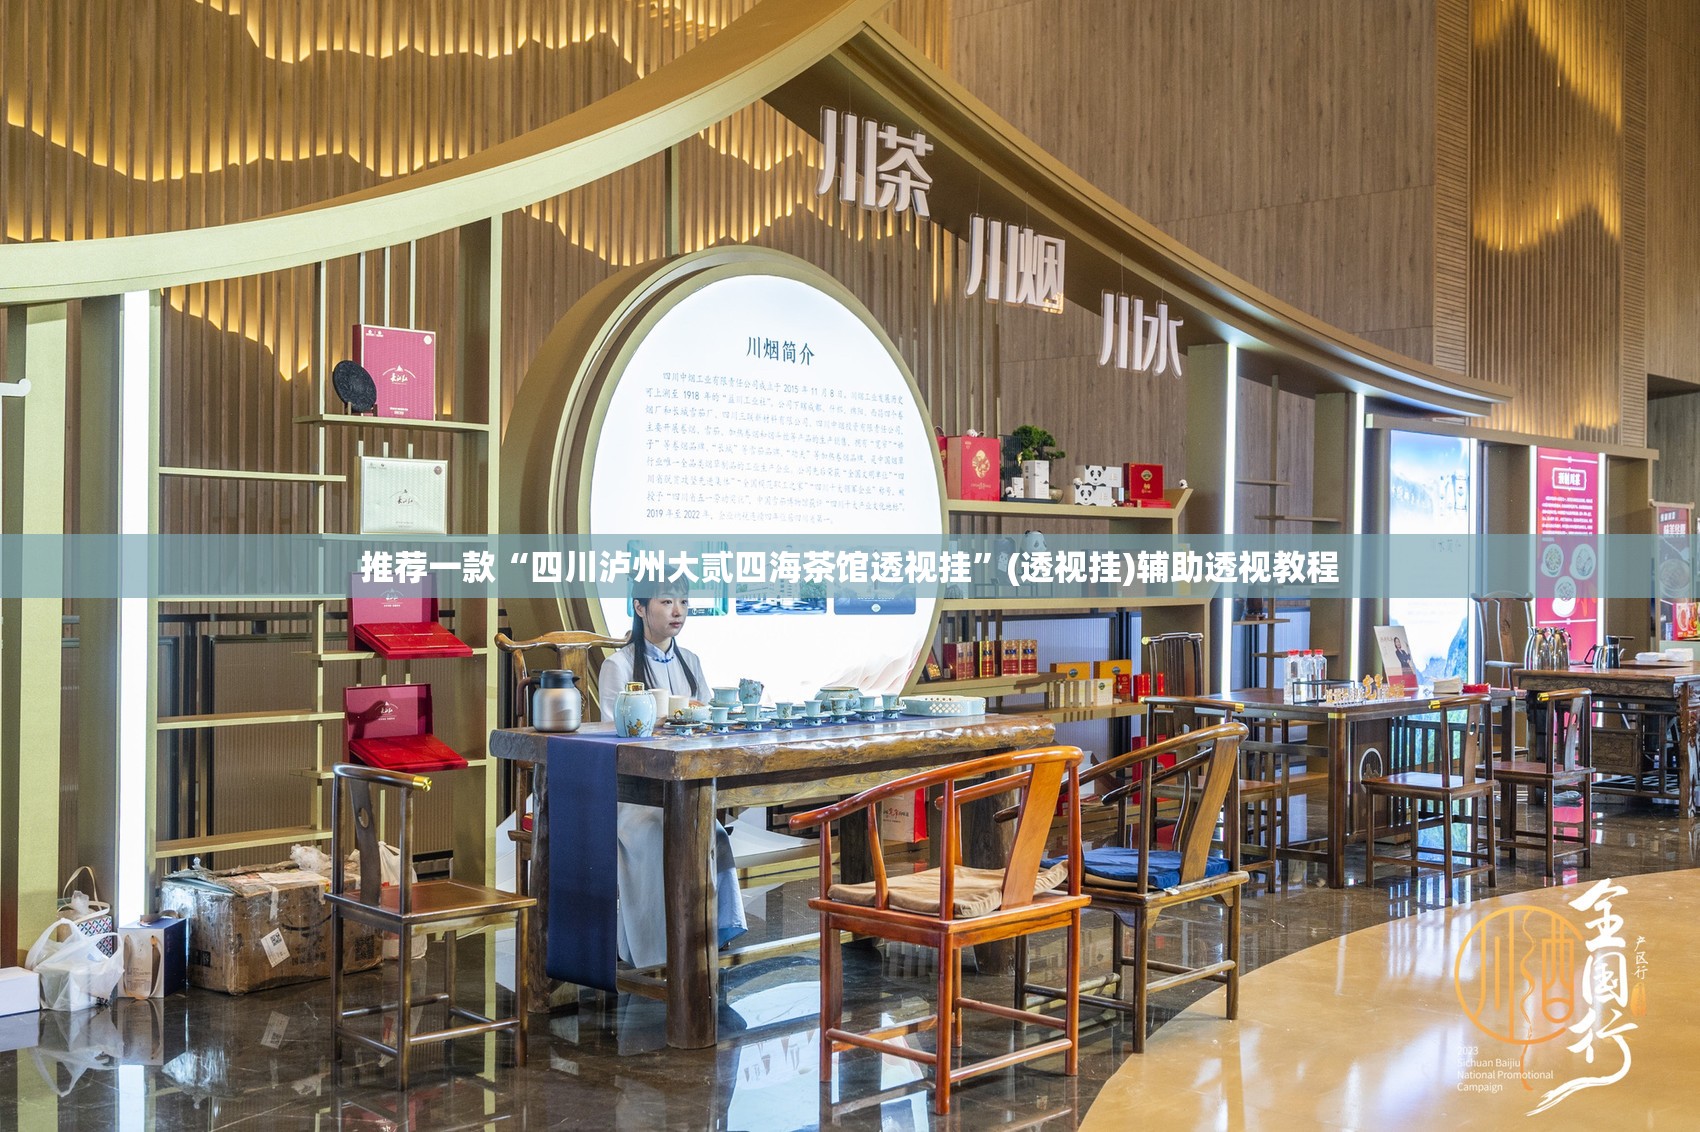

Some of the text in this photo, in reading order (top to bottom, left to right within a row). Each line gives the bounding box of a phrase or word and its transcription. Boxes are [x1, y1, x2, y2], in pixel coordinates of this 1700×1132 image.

[816, 106, 933, 219] 川茶
[965, 214, 1066, 313] 川烟
[746, 335, 815, 366] 川烟简介
[1099, 290, 1184, 377] 川水
